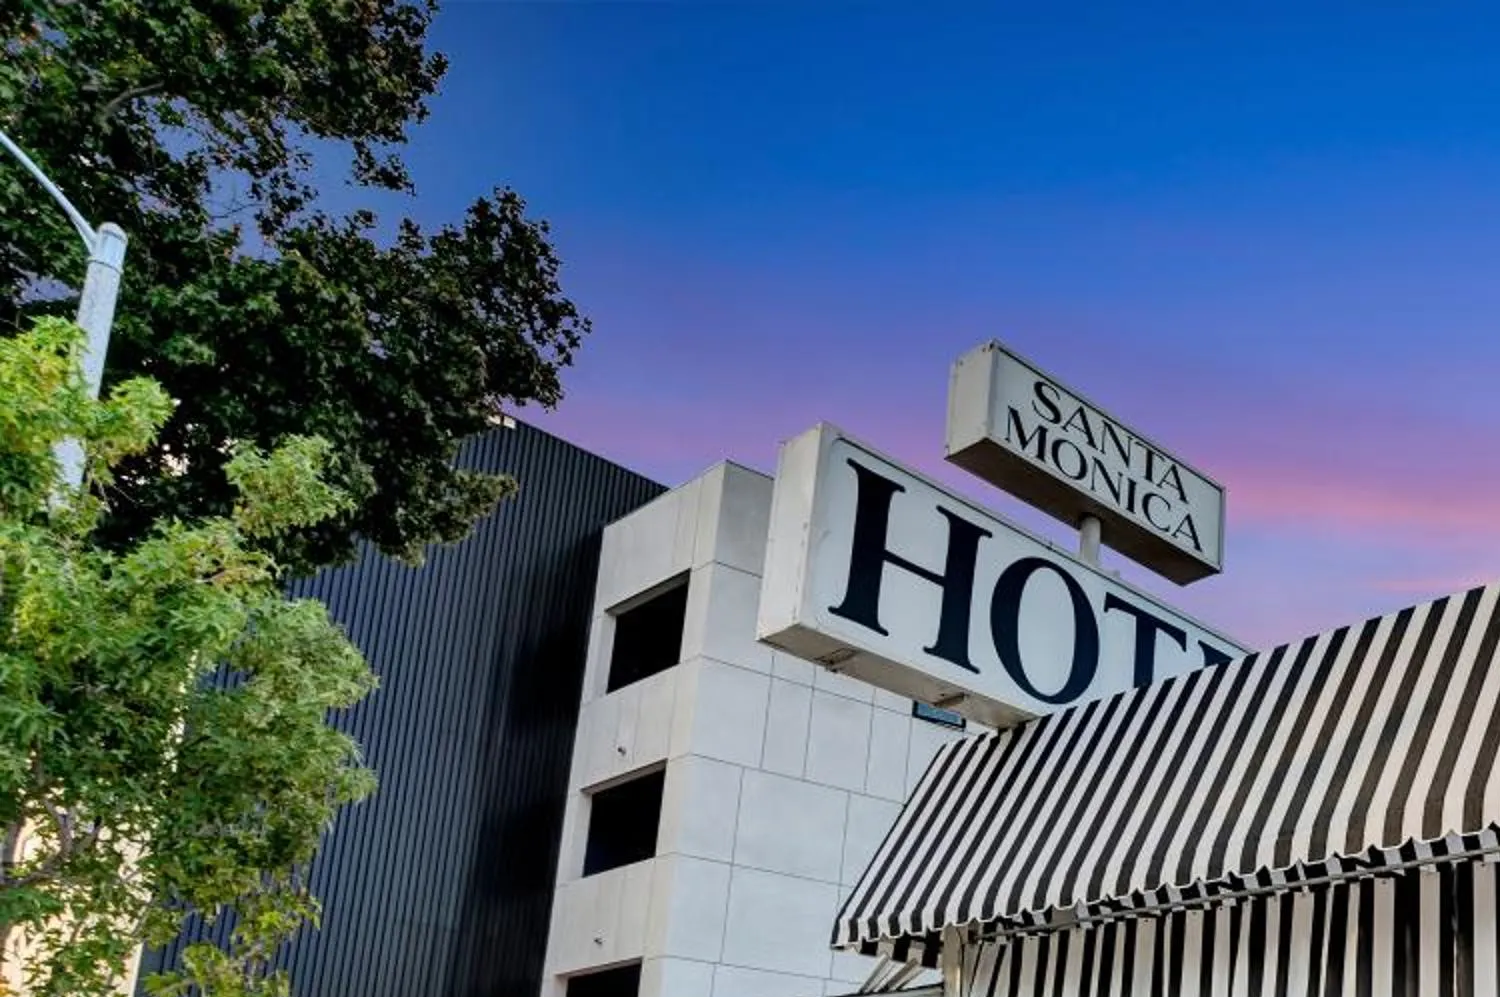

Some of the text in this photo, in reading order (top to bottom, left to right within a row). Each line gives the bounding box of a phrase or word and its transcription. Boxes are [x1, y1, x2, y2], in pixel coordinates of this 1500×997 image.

[1005, 404, 1203, 553] MONICA
[1031, 381, 1189, 504] SANTA
[827, 457, 1233, 705] HOT
